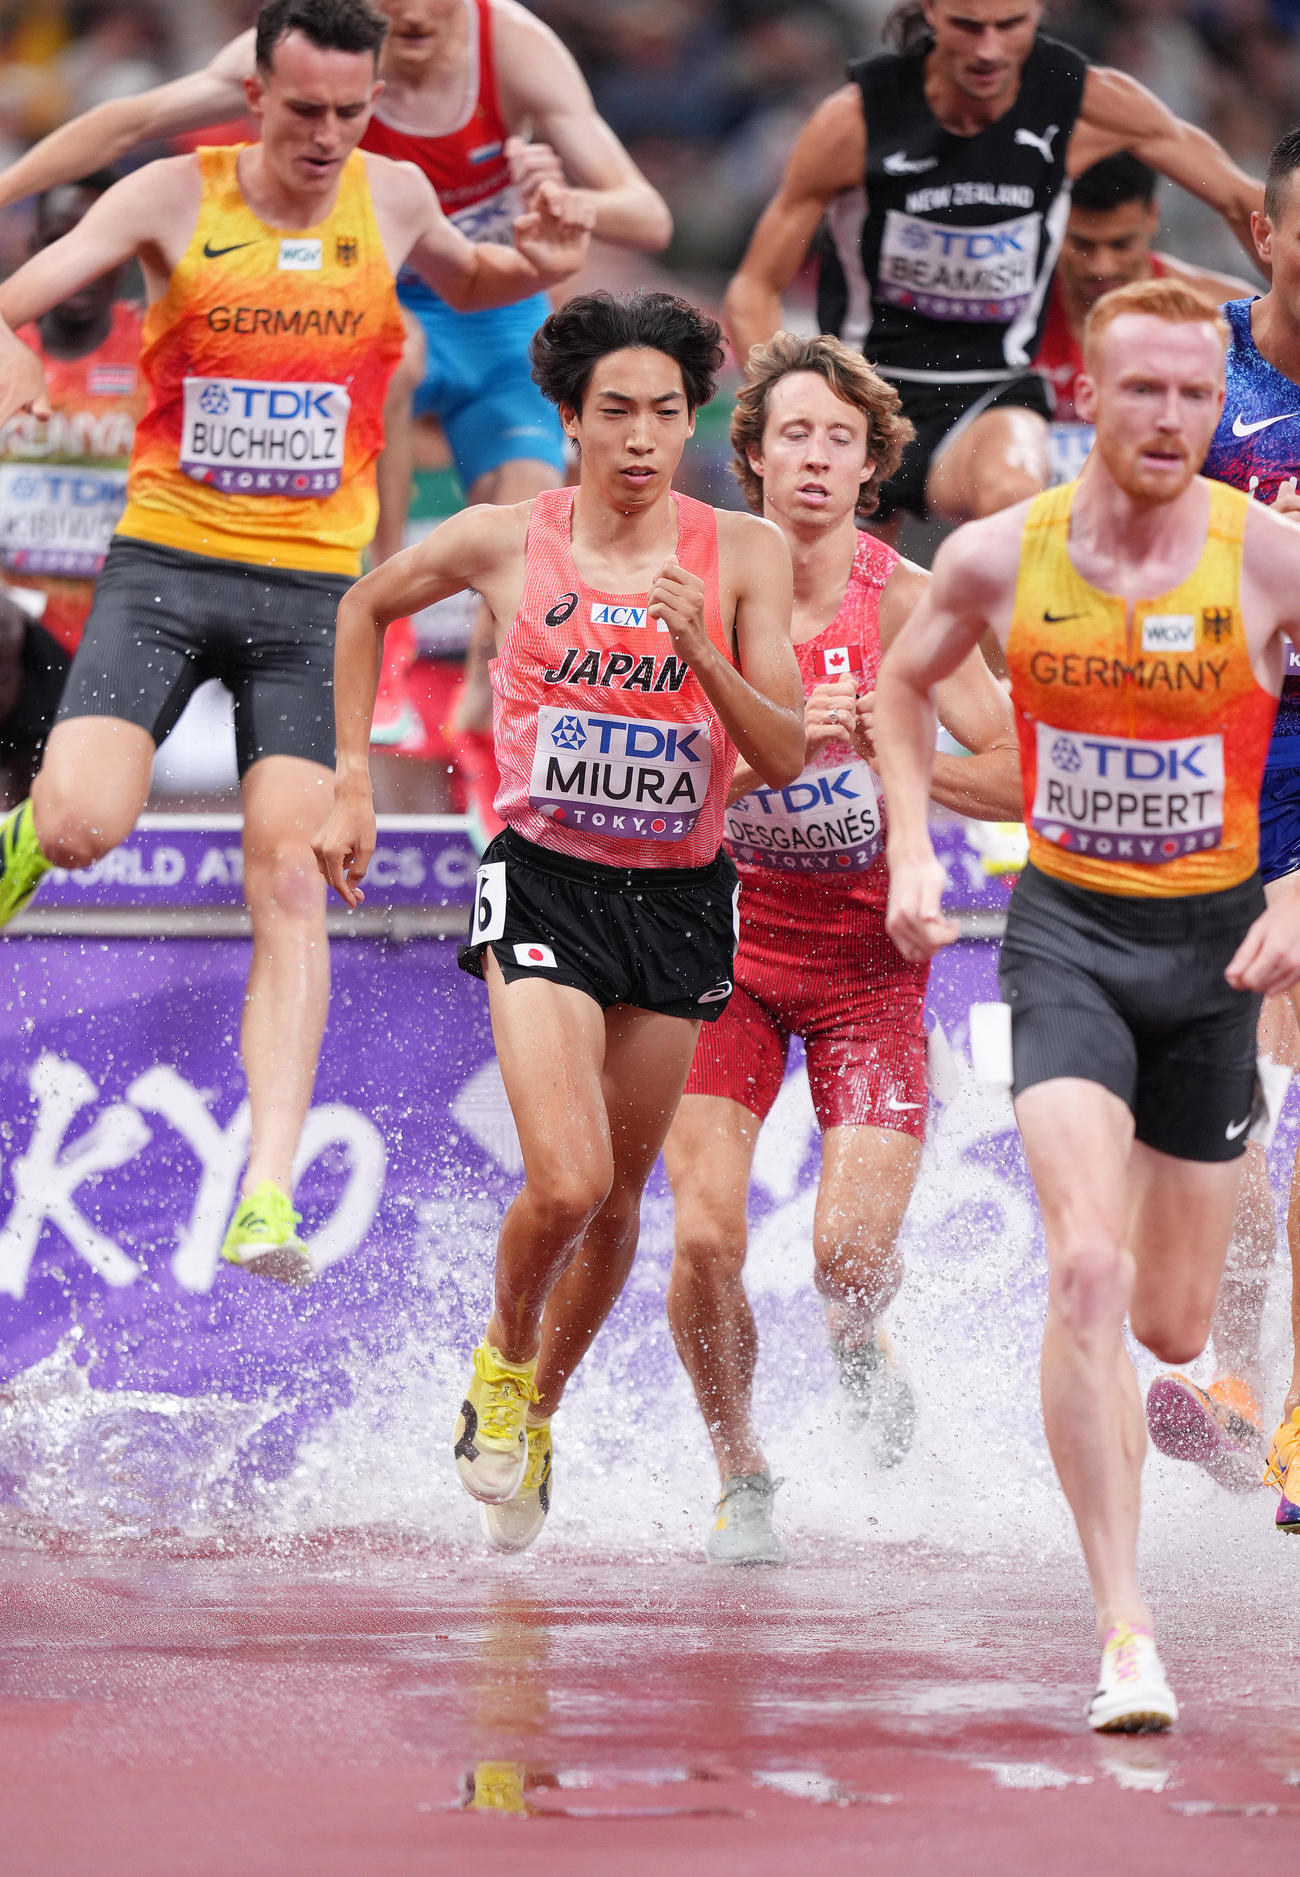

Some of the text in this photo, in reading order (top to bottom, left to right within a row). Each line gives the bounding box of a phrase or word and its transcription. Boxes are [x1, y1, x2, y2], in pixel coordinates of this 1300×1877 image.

[906, 181, 1035, 213] NEW ZEALAND
[933, 226, 1023, 259] TDK
[891, 256, 1026, 293] BEAMISH
[207, 306, 366, 337] GERMANY
[232, 387, 334, 419] TDK
[192, 423, 337, 461] BUCHHOLZ
[593, 606, 646, 626] ACN
[543, 648, 690, 693] JAPAN
[1030, 651, 1228, 690] GERMANY
[588, 718, 702, 763] TDK
[1083, 741, 1206, 780] TDK
[545, 756, 697, 805] MIURA
[750, 769, 861, 814] TDK
[1047, 779, 1214, 828] RUPPERT
[728, 808, 876, 850] DESGAGNÉS
[478, 877, 493, 932] 6
